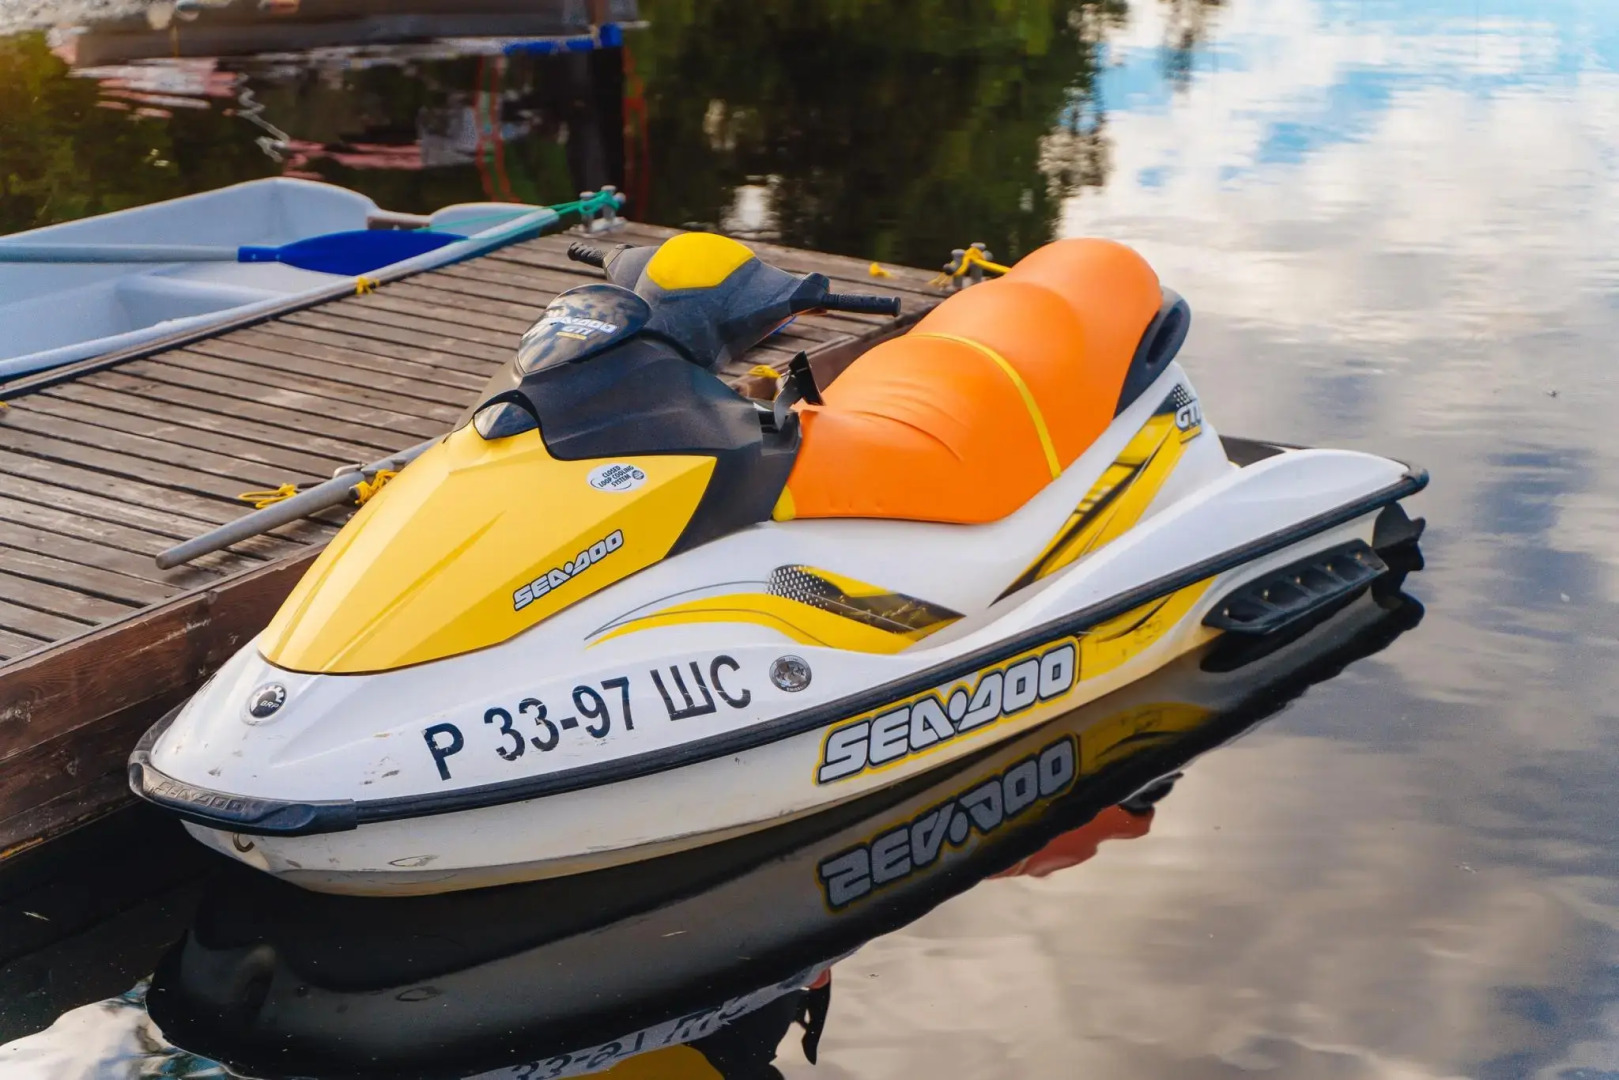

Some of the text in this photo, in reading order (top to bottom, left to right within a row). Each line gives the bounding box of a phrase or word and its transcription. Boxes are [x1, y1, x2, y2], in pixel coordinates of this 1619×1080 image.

[598, 476, 612, 487] LOOP
[612, 465, 634, 480] COOLING
[602, 465, 621, 478] CLOSED
[611, 474, 631, 487] SYSTEM
[260, 700, 280, 709] BRP
[484, 676, 634, 762] 33-97
[650, 655, 751, 722] ШС
